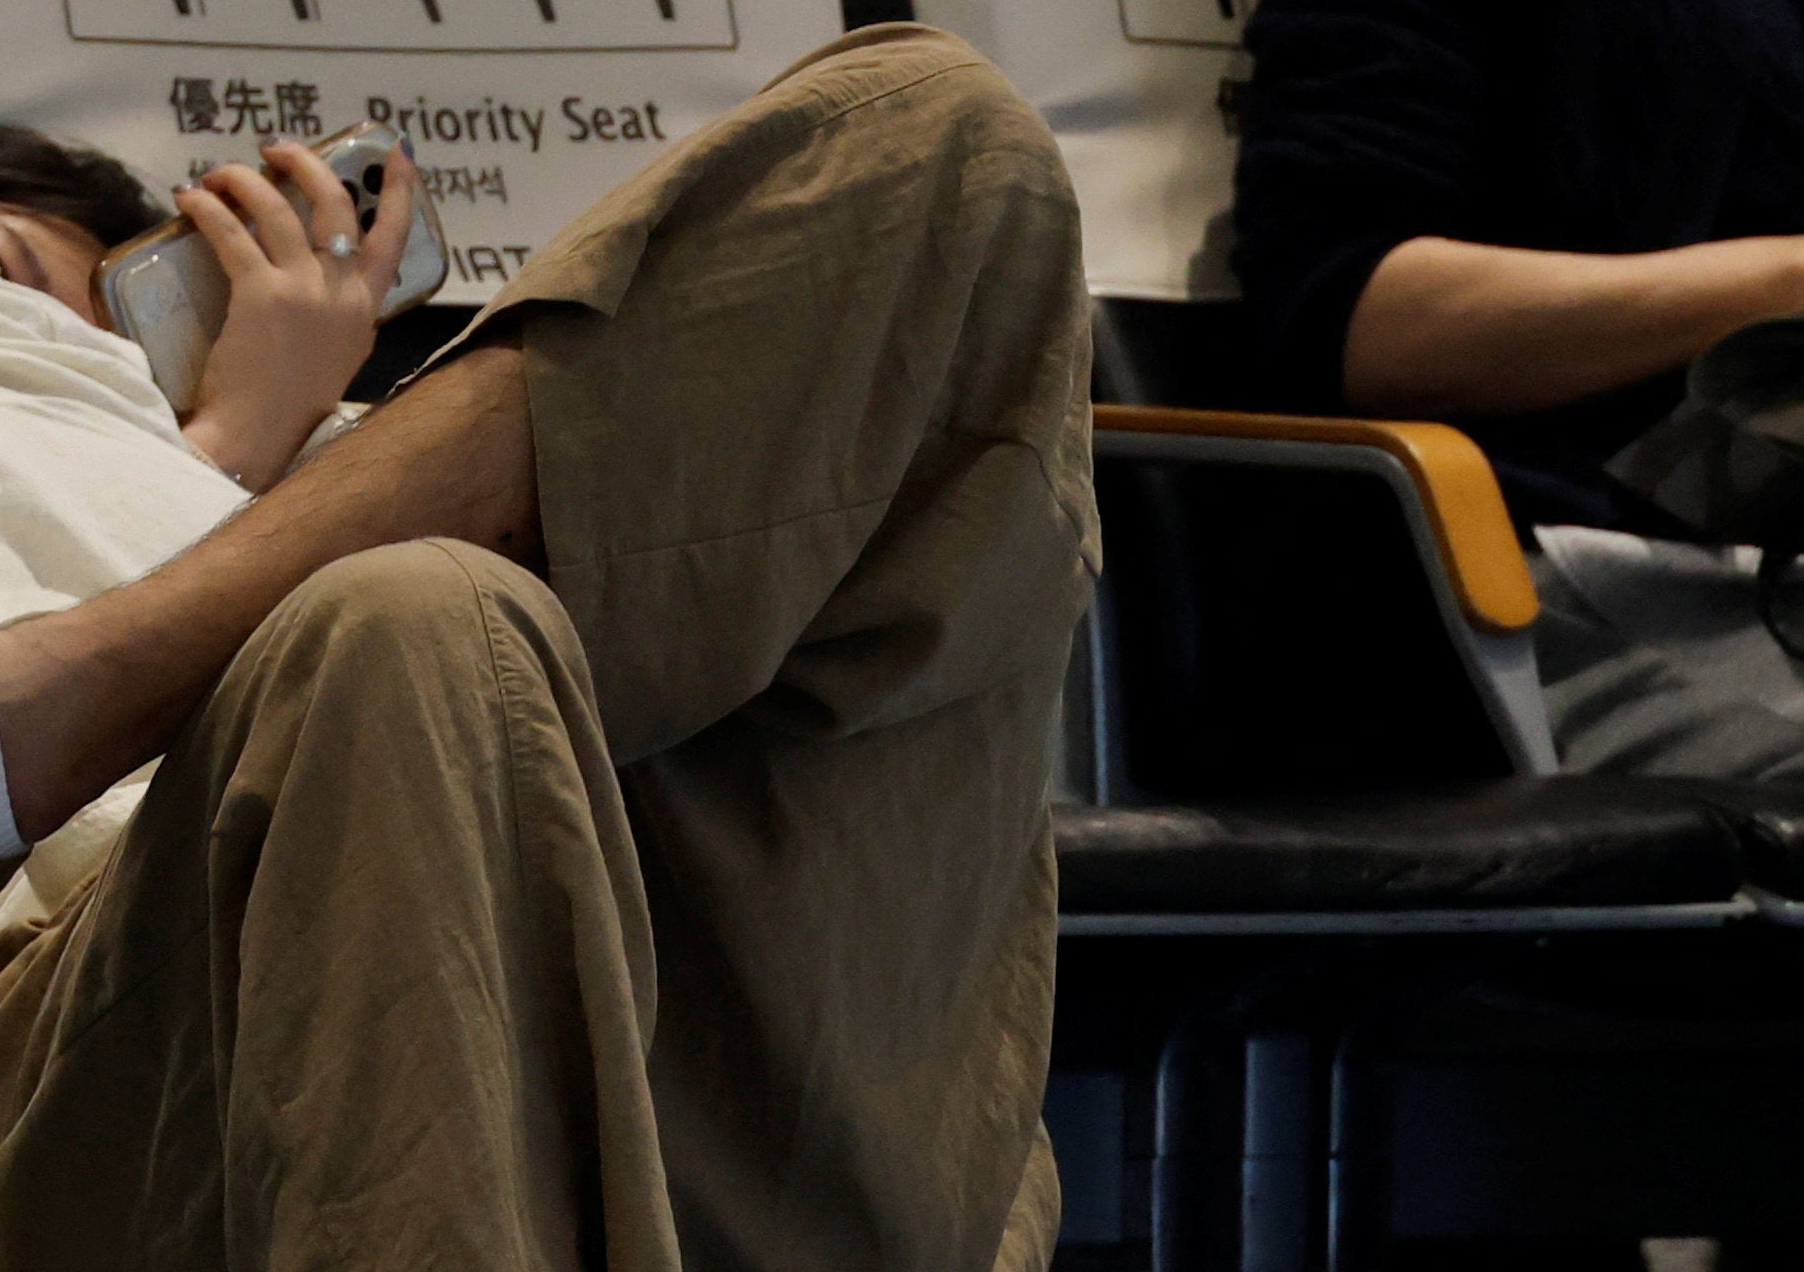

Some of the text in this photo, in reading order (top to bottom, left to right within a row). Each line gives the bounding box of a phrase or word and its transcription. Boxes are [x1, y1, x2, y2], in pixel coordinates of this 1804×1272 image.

[170, 77, 668, 152] 優先席 Priority Seat
